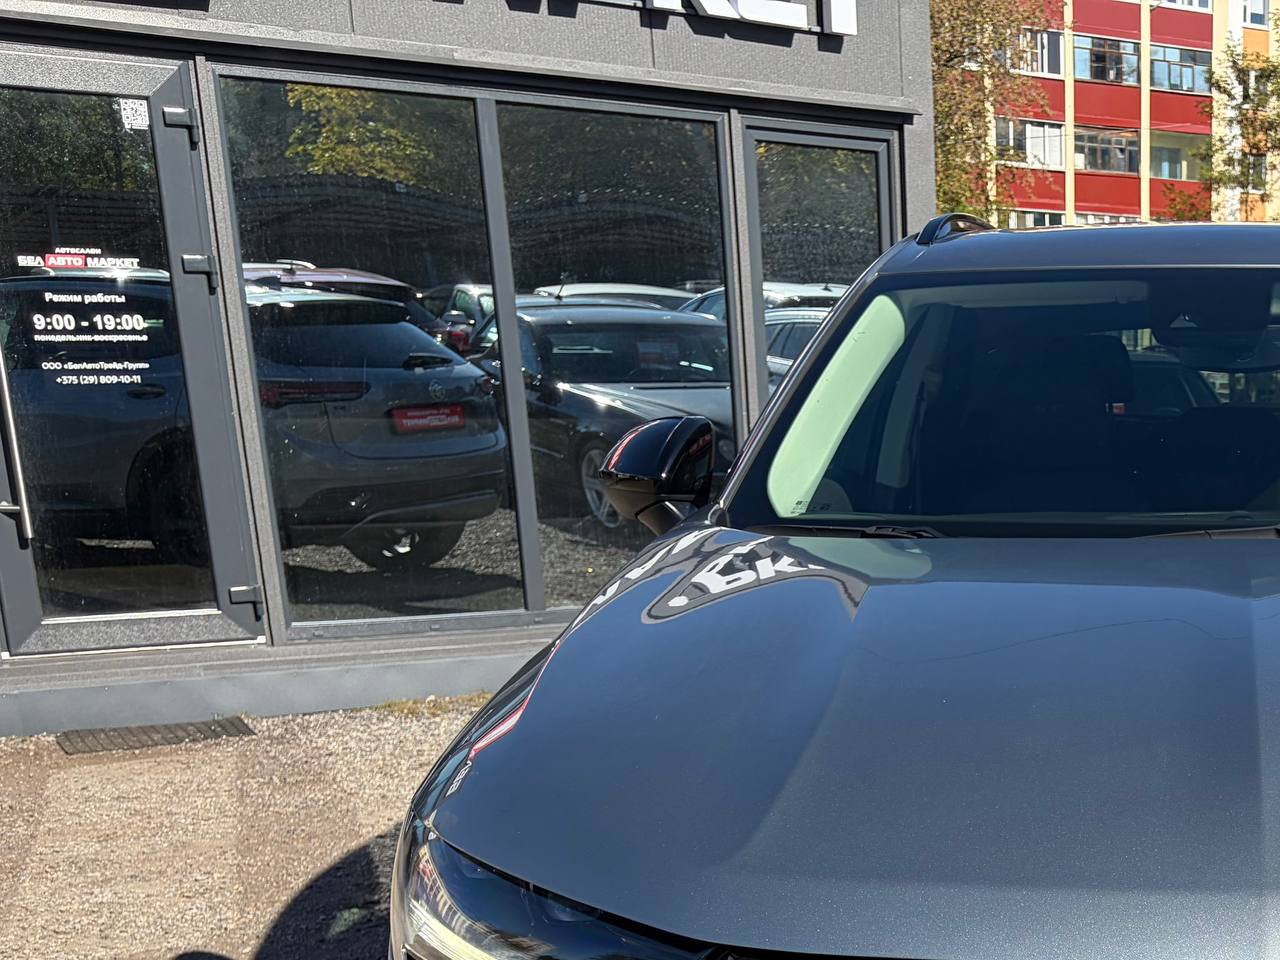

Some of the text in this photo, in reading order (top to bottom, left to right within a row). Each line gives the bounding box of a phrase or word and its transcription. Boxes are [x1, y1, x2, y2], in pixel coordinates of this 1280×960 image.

[44, 292, 126, 304] Режим работы
[33, 314, 76, 330] 9:00
[93, 314, 145, 330] 19:00
[41, 362, 62, 370] ООО
[56, 375, 141, 385] +375 (29) 809-10-11
